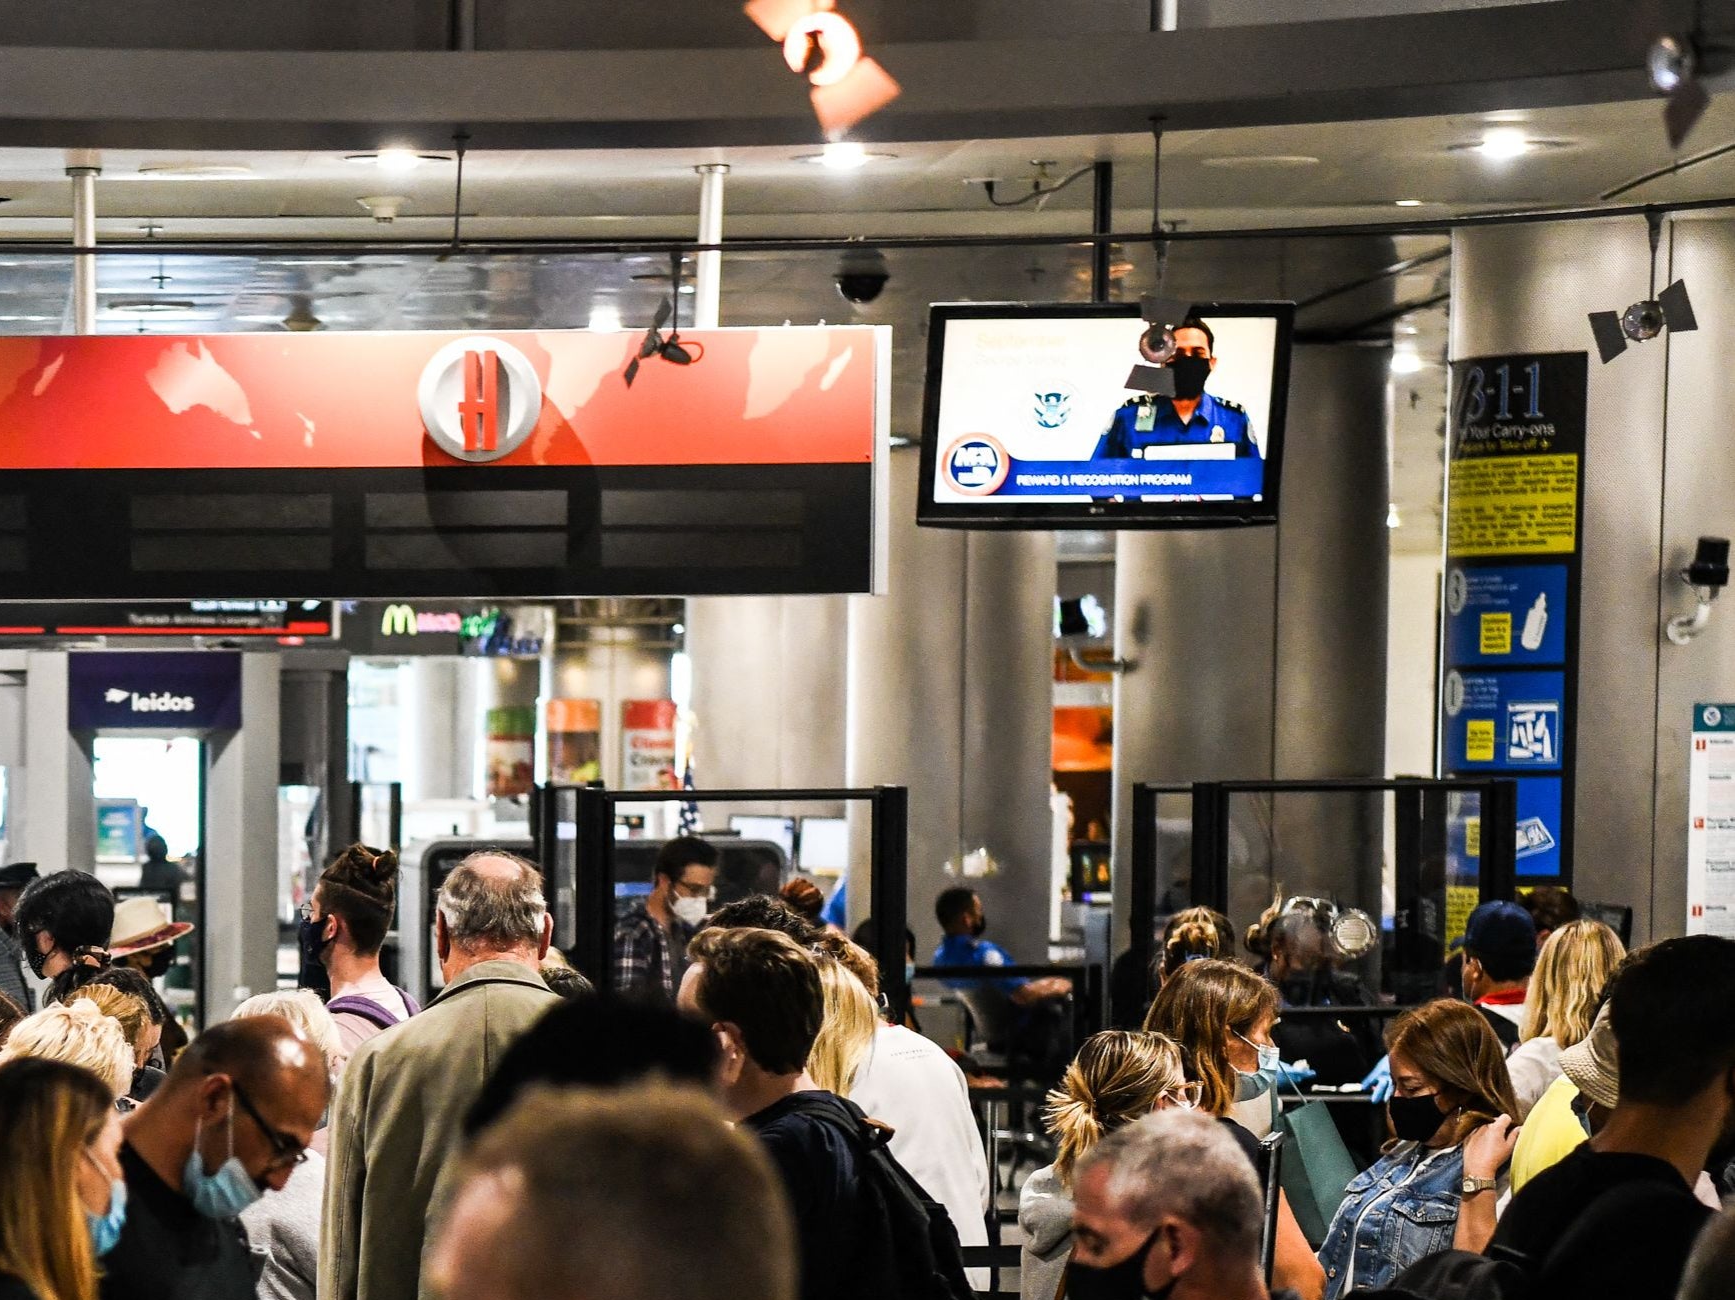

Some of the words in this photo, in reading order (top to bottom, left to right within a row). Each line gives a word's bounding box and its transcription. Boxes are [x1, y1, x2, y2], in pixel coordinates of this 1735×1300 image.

[459, 350, 497, 452] H
[1492, 423, 1555, 440] Carry-ons
[1016, 474, 1060, 486] REWARD
[1061, 474, 1068, 486] &
[1070, 474, 1139, 486] RECOGNITION
[1140, 474, 1192, 486] PROGRAM
[131, 691, 195, 712] leidos
